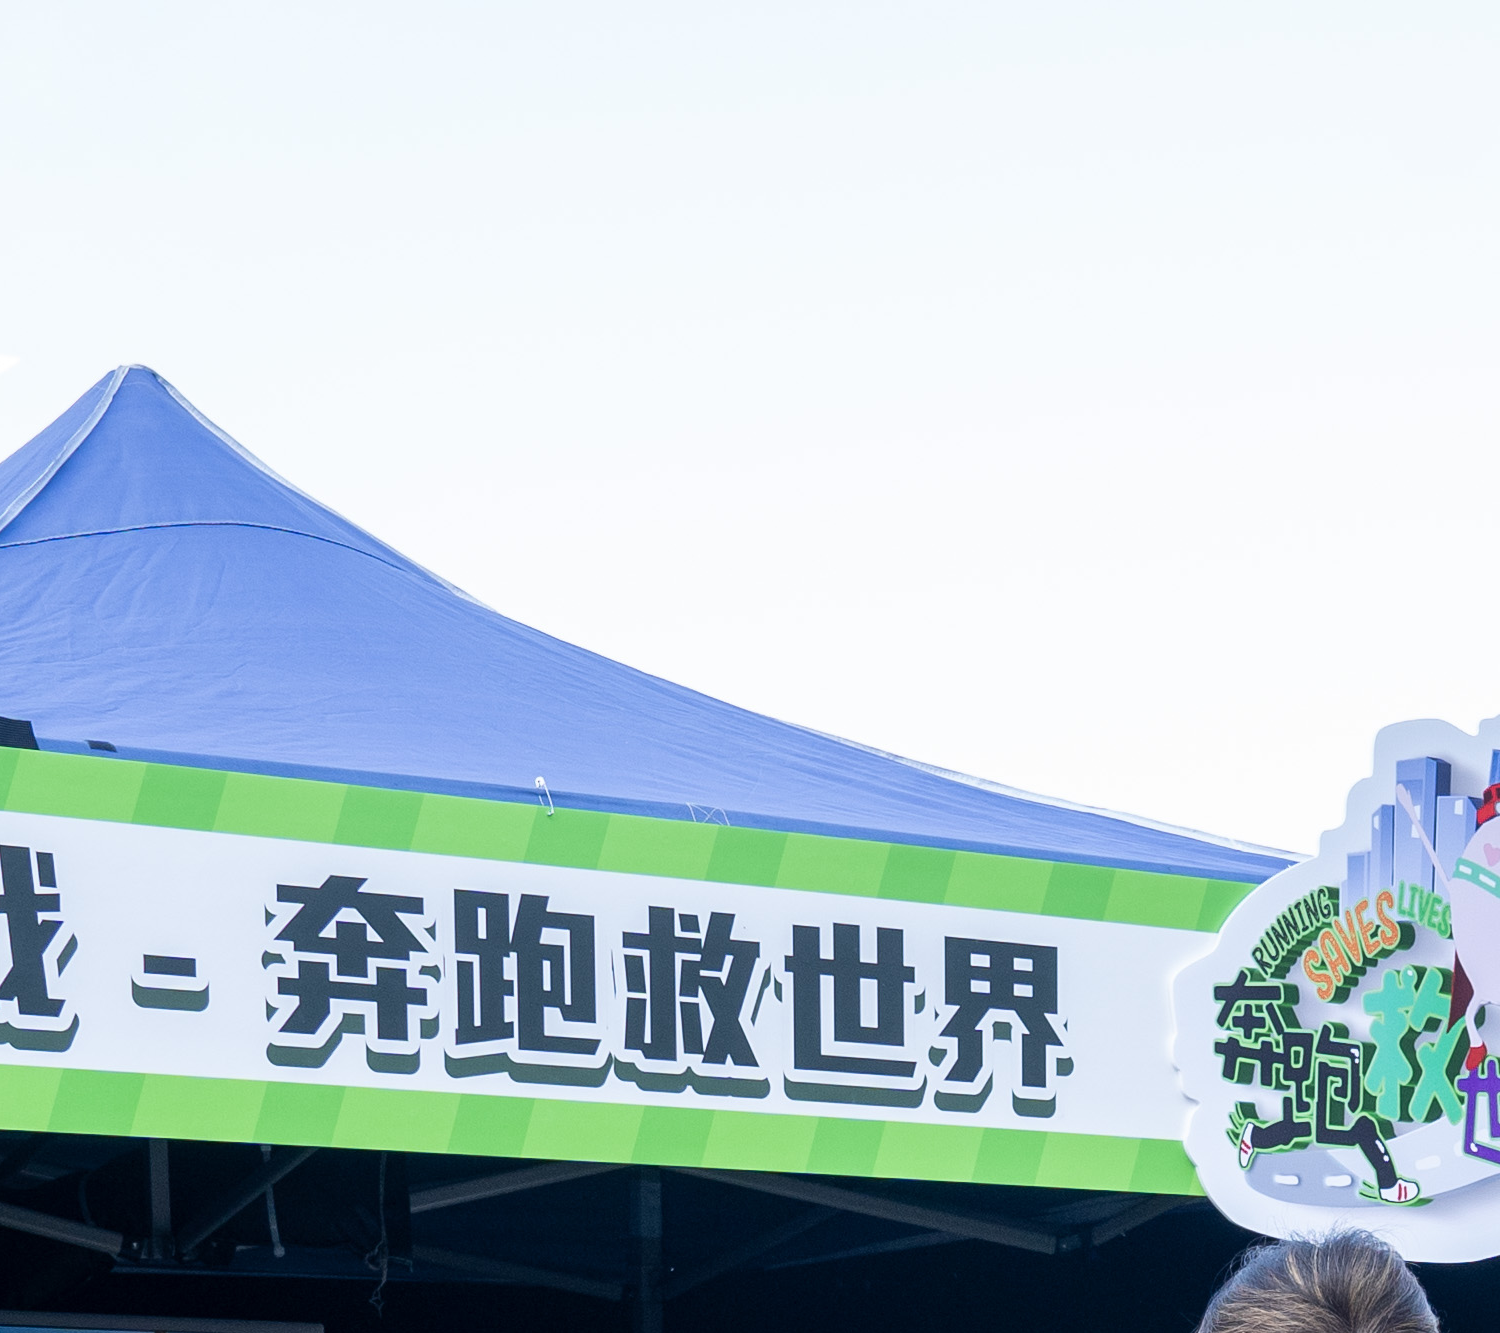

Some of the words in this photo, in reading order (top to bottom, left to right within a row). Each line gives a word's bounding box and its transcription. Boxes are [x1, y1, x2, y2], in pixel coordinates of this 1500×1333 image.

[266, 874, 1074, 1118] 奔跑救世界
[1251, 886, 1336, 977] RUNNING
[1303, 889, 1401, 1002] SAVES
[1398, 880, 1451, 940] LIVES
